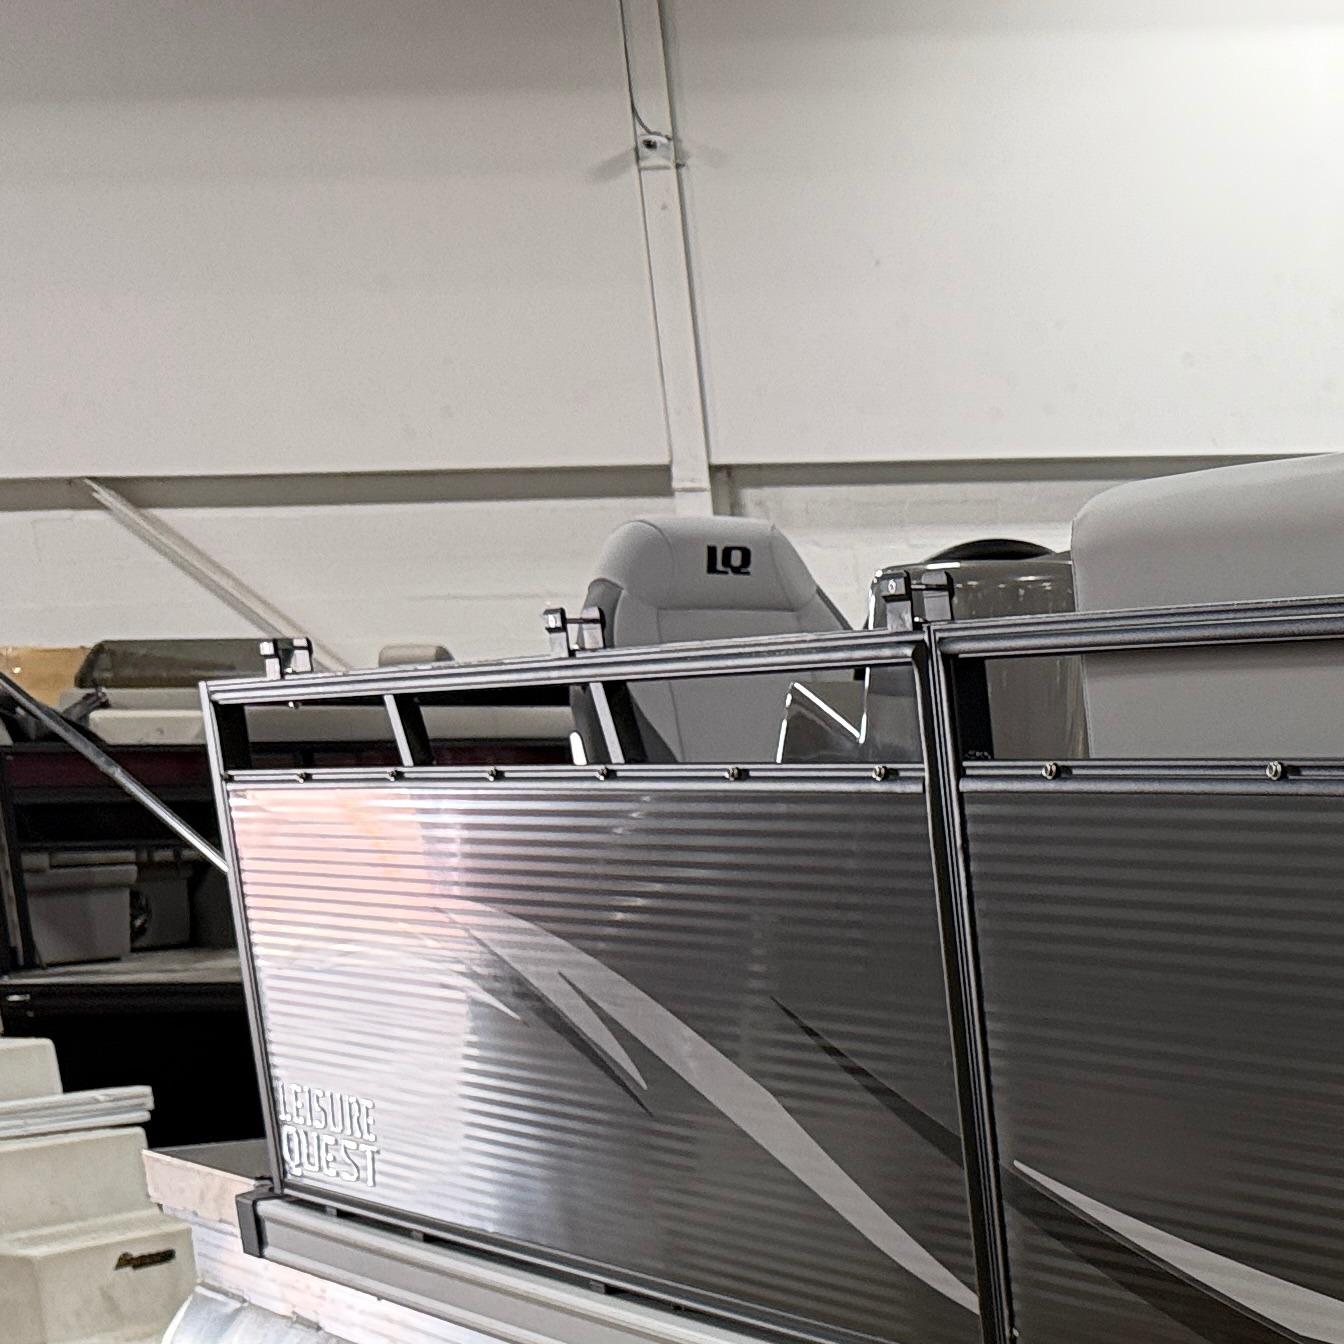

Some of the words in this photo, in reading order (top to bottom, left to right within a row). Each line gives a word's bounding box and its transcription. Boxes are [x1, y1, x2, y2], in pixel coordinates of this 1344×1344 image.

[706, 545, 752, 575] LQ
[278, 1083, 377, 1142] LEISURE
[281, 1124, 378, 1187] QUEST
